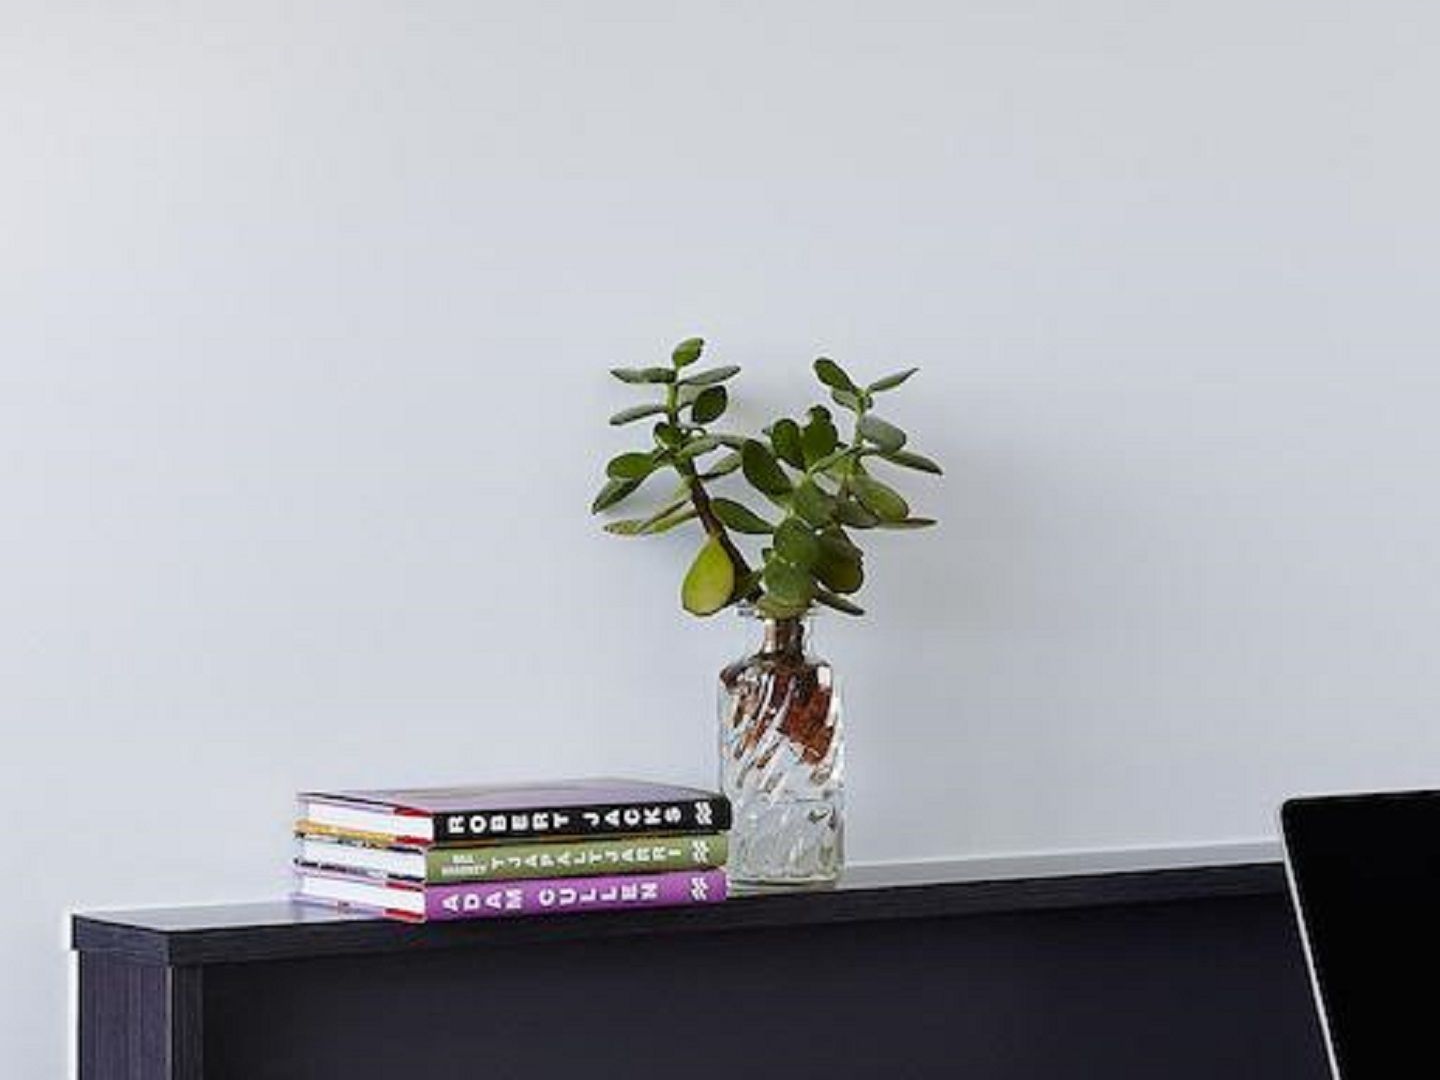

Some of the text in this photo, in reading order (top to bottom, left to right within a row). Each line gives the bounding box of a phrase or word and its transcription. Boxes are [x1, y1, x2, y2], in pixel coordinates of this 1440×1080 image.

[448, 805, 682, 834] ROBERT JACKS
[490, 846, 682, 870] TJAPALTJARRI
[441, 881, 659, 912] ADAM CULLEN
